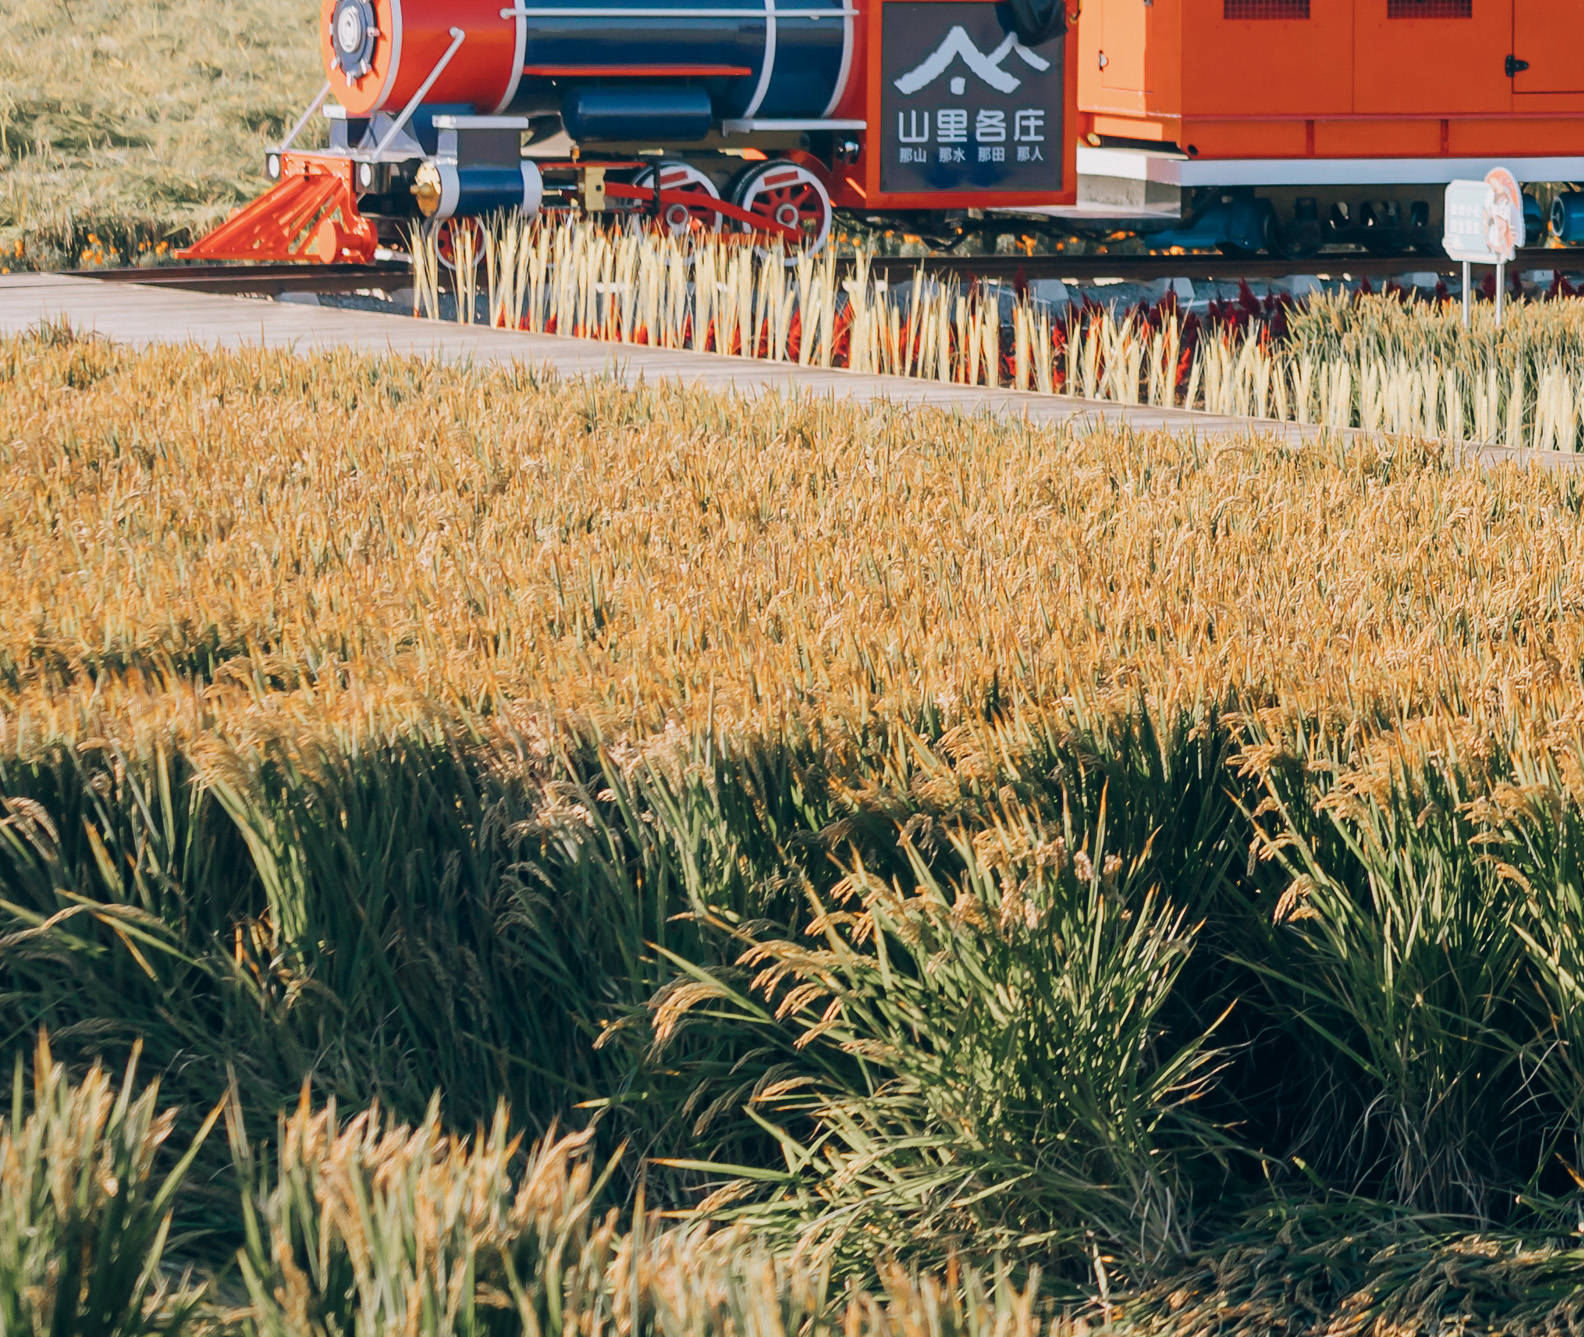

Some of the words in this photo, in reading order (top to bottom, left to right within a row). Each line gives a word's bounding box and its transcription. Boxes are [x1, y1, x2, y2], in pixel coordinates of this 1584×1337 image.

[898, 108, 1045, 143] 山里各庄
[899, 147, 927, 163] 那山
[939, 147, 966, 162] 那水
[978, 147, 1005, 162] 那田
[1017, 146, 1044, 162] 那人
